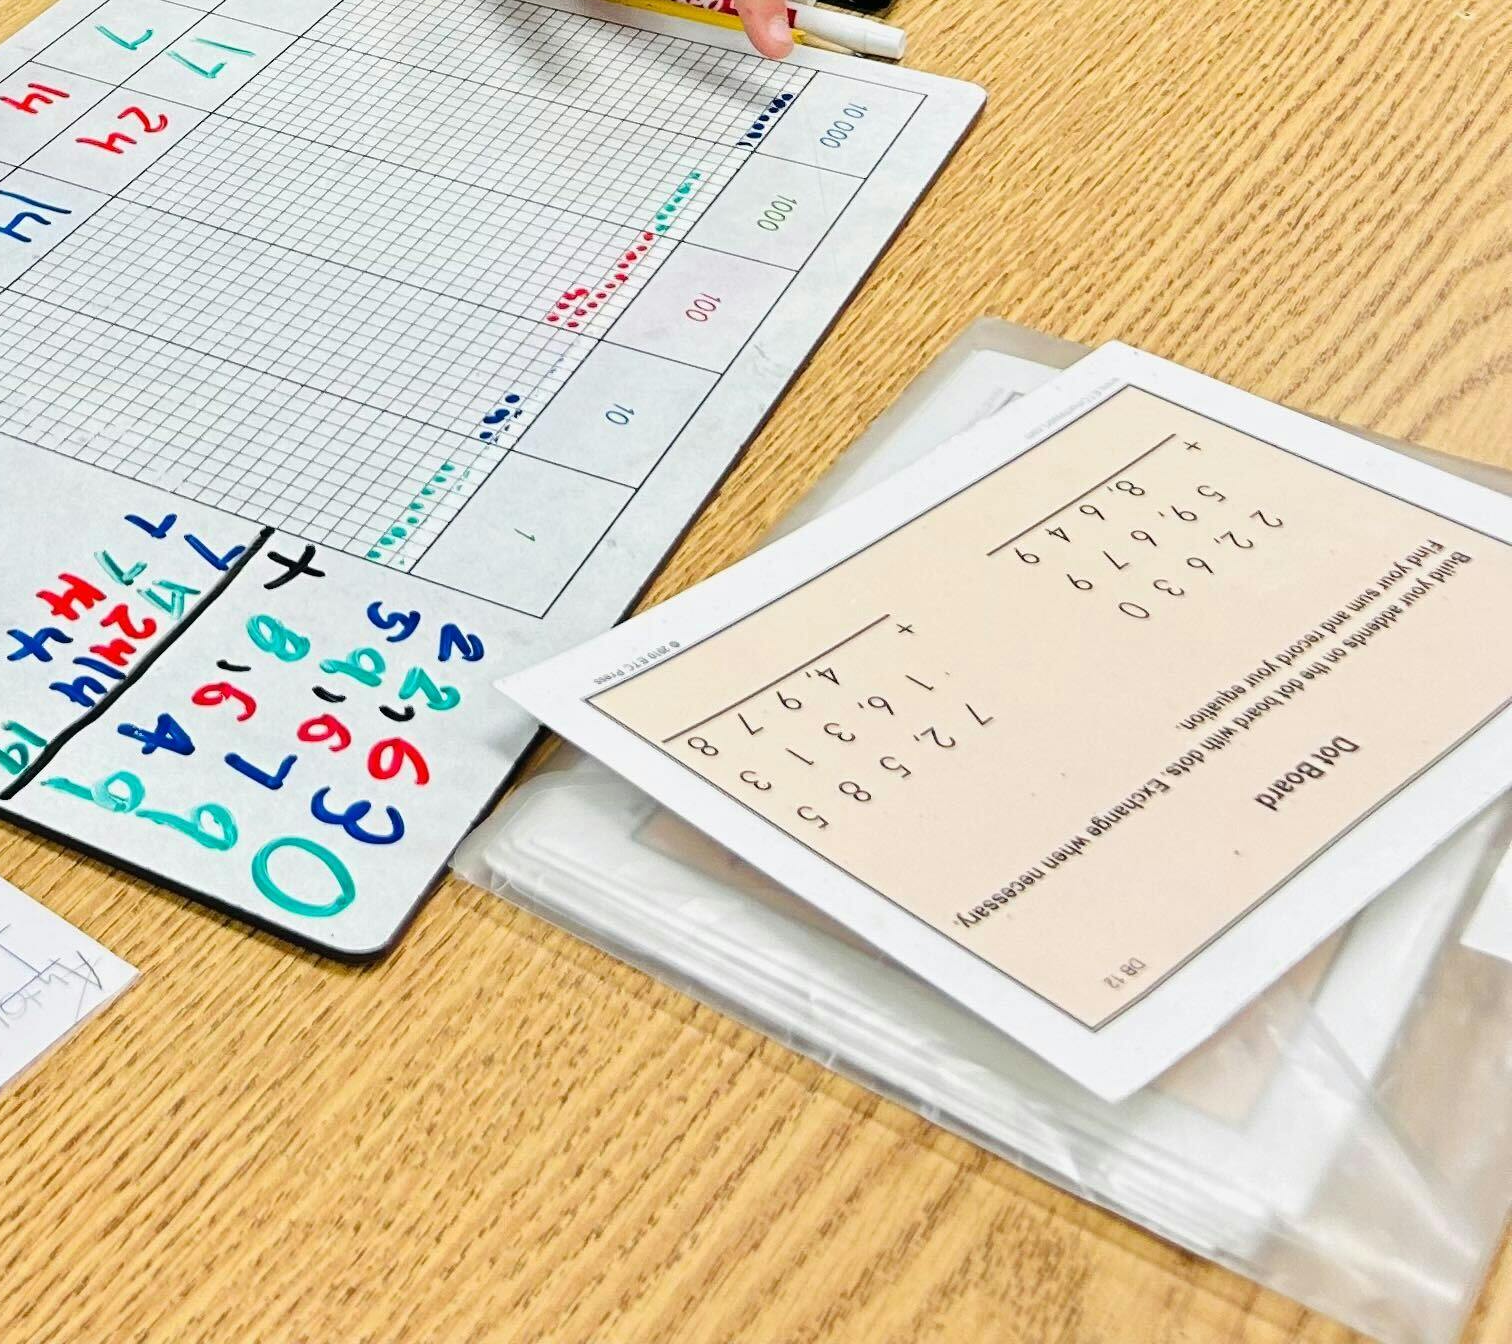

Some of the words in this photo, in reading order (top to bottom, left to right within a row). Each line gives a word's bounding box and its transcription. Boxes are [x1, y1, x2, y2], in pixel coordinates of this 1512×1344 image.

[95, 23, 154, 51] 7
[164, 36, 257, 80] 17
[0, 82, 71, 114] 14
[75, 105, 168, 155] 24
[757, 195, 799, 233] 1000
[684, 292, 722, 324] 100
[605, 406, 636, 426] 10
[1404, 539, 1447, 568] Find
[1427, 551, 1473, 584] Build
[1375, 560, 1413, 592] your
[1344, 588, 1382, 613] sum
[1397, 577, 1435, 608] your
[1318, 610, 1353, 635] and
[1341, 604, 1405, 650] addends
[1273, 629, 1327, 667] record
[1321, 647, 1349, 665] on
[1242, 659, 1282, 689] your
[1298, 661, 1333, 681] the
[1272, 678, 1305, 700] dot
[1175, 684, 1248, 732] equation.
[1231, 695, 1286, 731] board
[1199, 725, 1240, 753] with
[1309, 735, 1361, 768] Dot
[1159, 749, 1206, 777] dots.
[1253, 760, 1327, 813] Board
[1085, 777, 1172, 838] Exchange
[1040, 835, 1092, 870] when
[952, 866, 1047, 929] necessary.
